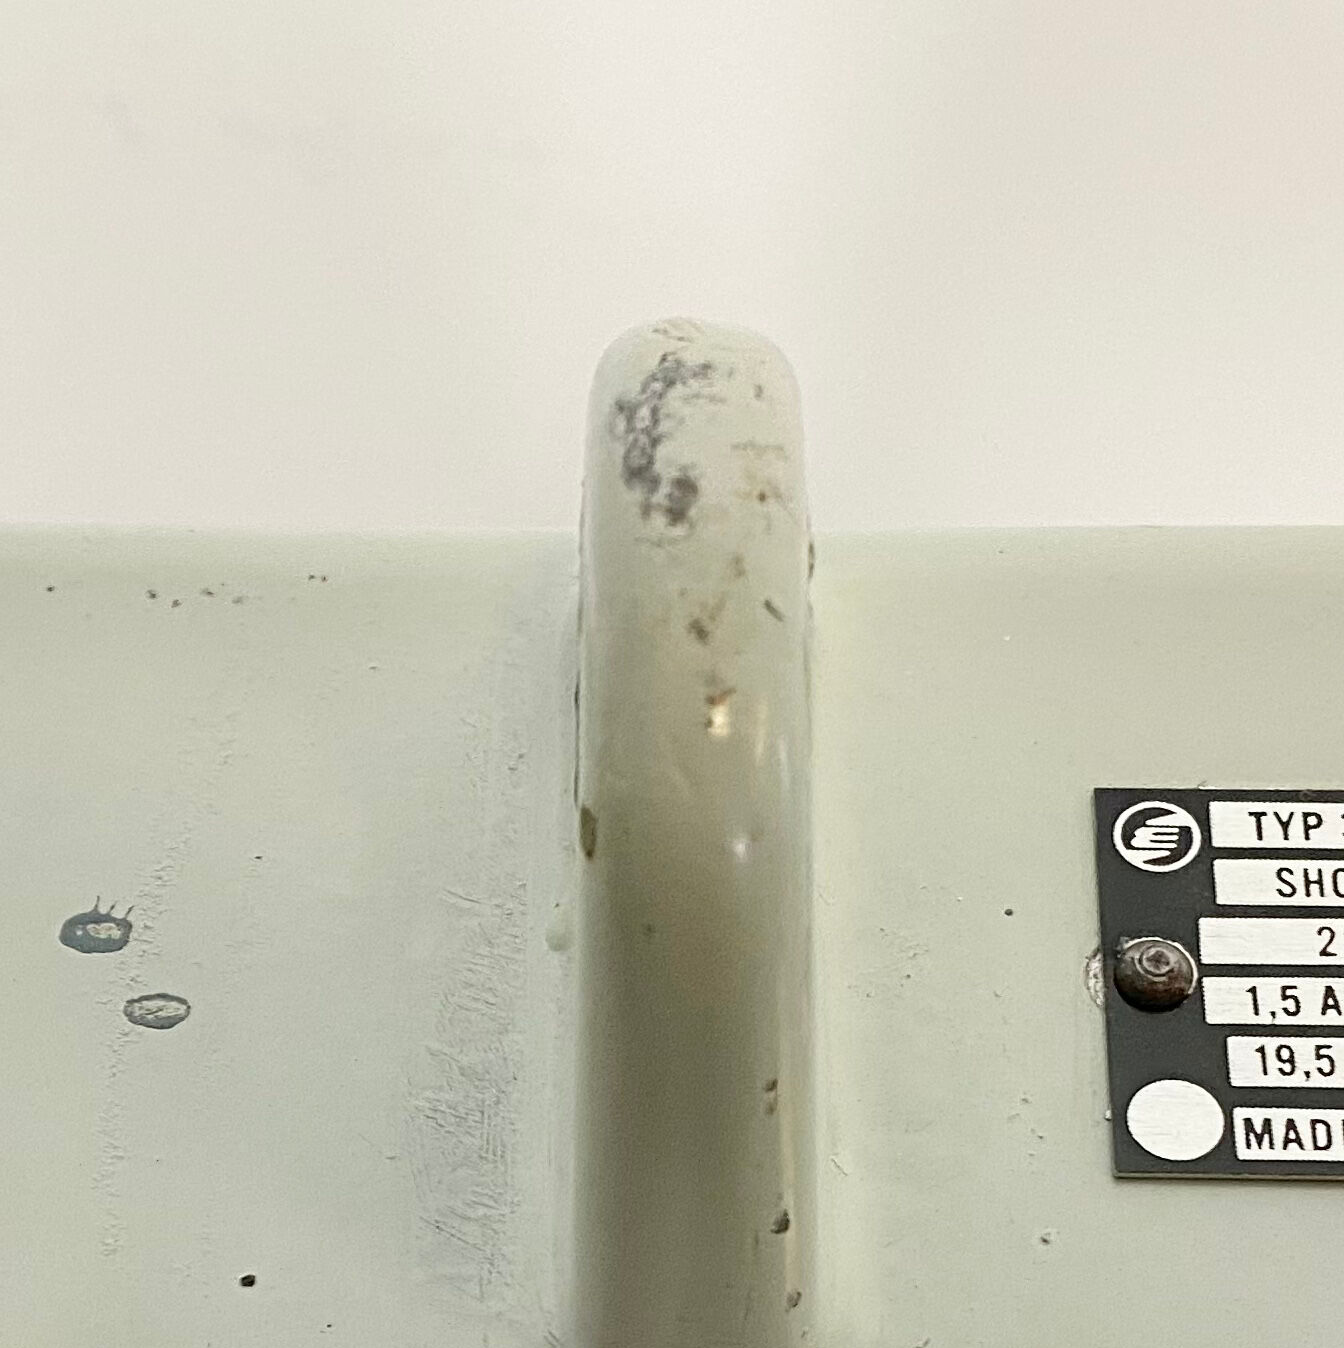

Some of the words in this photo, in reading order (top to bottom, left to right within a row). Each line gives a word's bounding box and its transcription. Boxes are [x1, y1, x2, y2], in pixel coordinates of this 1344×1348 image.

[1247, 811, 1324, 842] TYP
[1245, 985, 1302, 1020] 1,5
[1320, 985, 1343, 1017] A
[1254, 1044, 1336, 1082] 19,5
